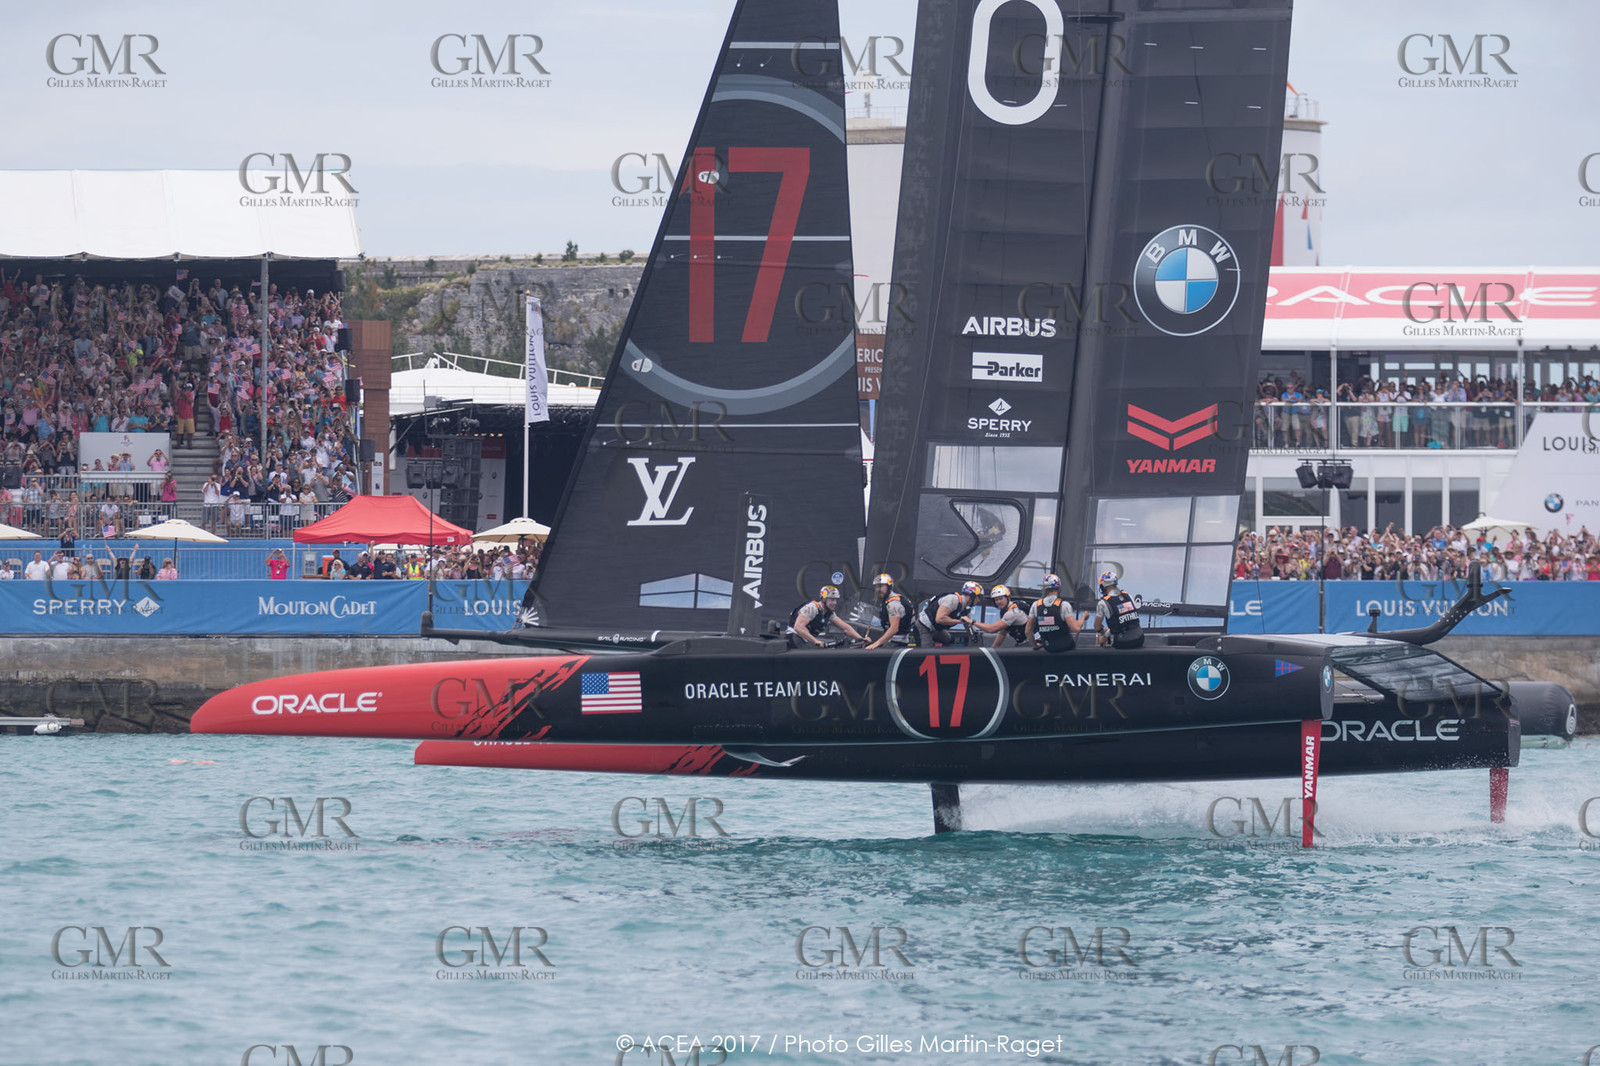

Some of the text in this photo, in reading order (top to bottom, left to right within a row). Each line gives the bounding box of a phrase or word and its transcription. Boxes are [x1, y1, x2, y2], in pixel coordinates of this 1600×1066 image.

[678, 146, 811, 343] 17
[1146, 229, 1231, 264] BMW
[1266, 285, 1598, 306] ACLE
[961, 316, 1057, 338] AIRBUS
[857, 348, 883, 363] ERIC
[529, 335, 541, 417] LOUIS VUITTON
[986, 361, 1042, 378] Parker
[967, 417, 1032, 432] SPERRY
[1543, 437, 1597, 451] LOUIS
[1127, 458, 1217, 474] YANMAR
[742, 504, 768, 609] AIRBUS
[33, 599, 126, 616] SPERRY
[463, 600, 522, 617] LOUIS
[1356, 600, 1416, 617] LOUIS
[1190, 658, 1226, 672] BMW
[1045, 672, 1152, 688] PANERAI
[685, 680, 841, 700] ORACLE TEAM USA
[919, 654, 970, 728] 17
[251, 692, 378, 715] ORACLE
[1304, 735, 1315, 799] YANMAR
